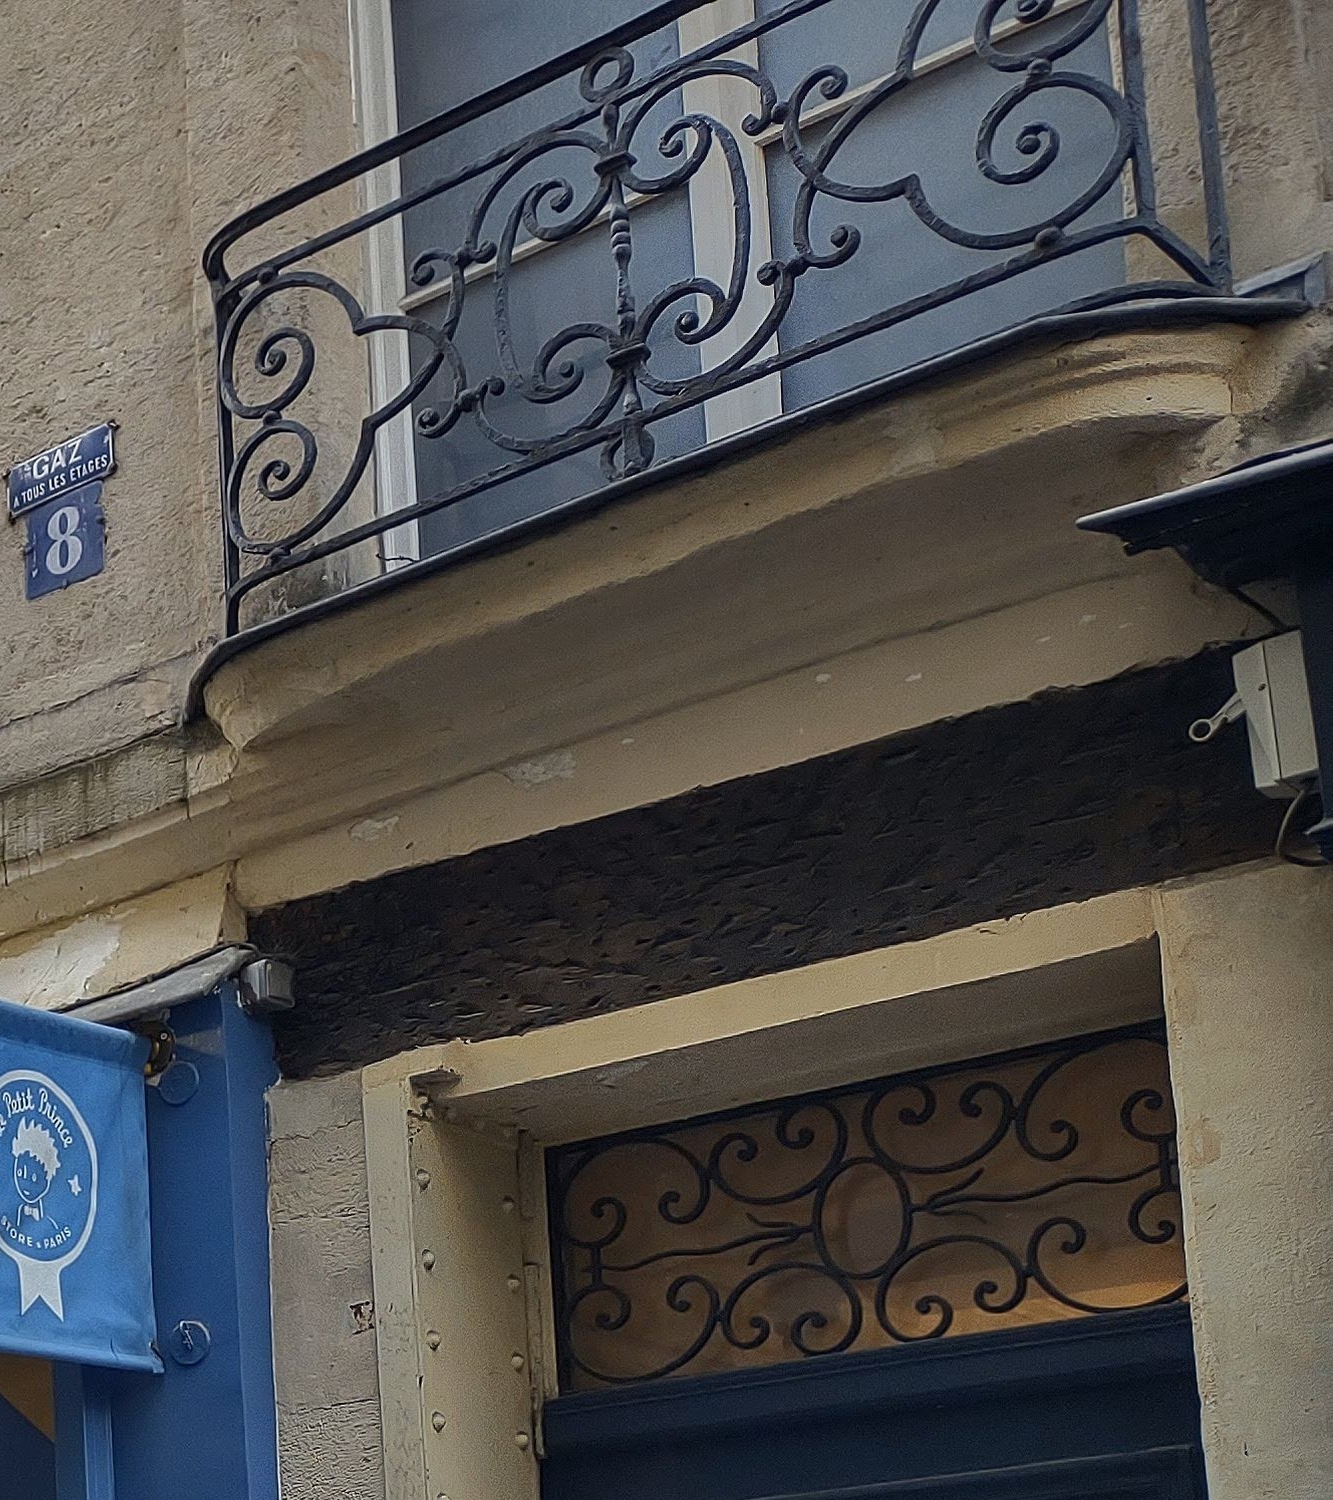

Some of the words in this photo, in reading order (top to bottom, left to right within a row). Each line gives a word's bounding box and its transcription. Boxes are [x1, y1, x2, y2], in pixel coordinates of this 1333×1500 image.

[32, 438, 82, 479] GAZ
[21, 482, 45, 503] TOUS
[48, 475, 66, 491] LES
[45, 505, 82, 575] 8
[2, 1087, 34, 1117] Petit
[37, 1086, 73, 1148] Prince
[0, 1214, 34, 1247] STORE
[43, 1225, 72, 1249] PARIS
